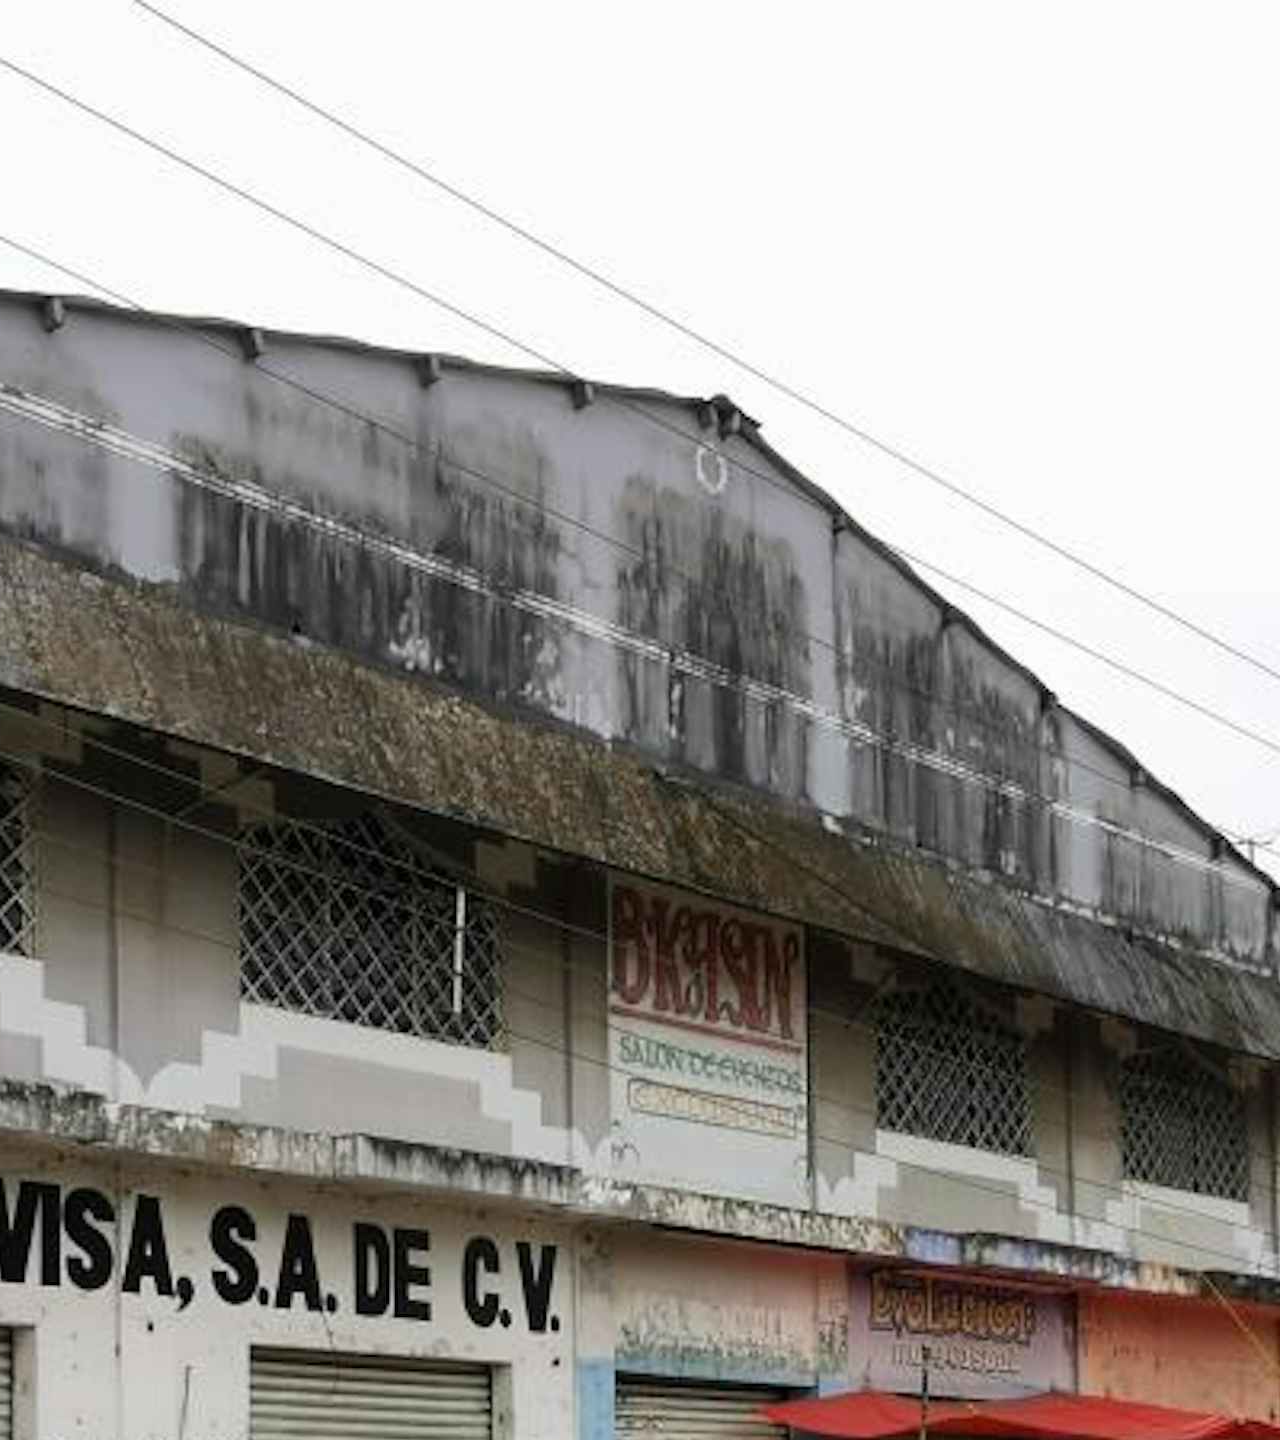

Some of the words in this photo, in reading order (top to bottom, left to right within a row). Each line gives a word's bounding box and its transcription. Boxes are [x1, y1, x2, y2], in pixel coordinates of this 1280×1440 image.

[209, 1205, 338, 1315] S.A.
[354, 1222, 432, 1322] DE
[462, 1236, 561, 1333] C.V.
